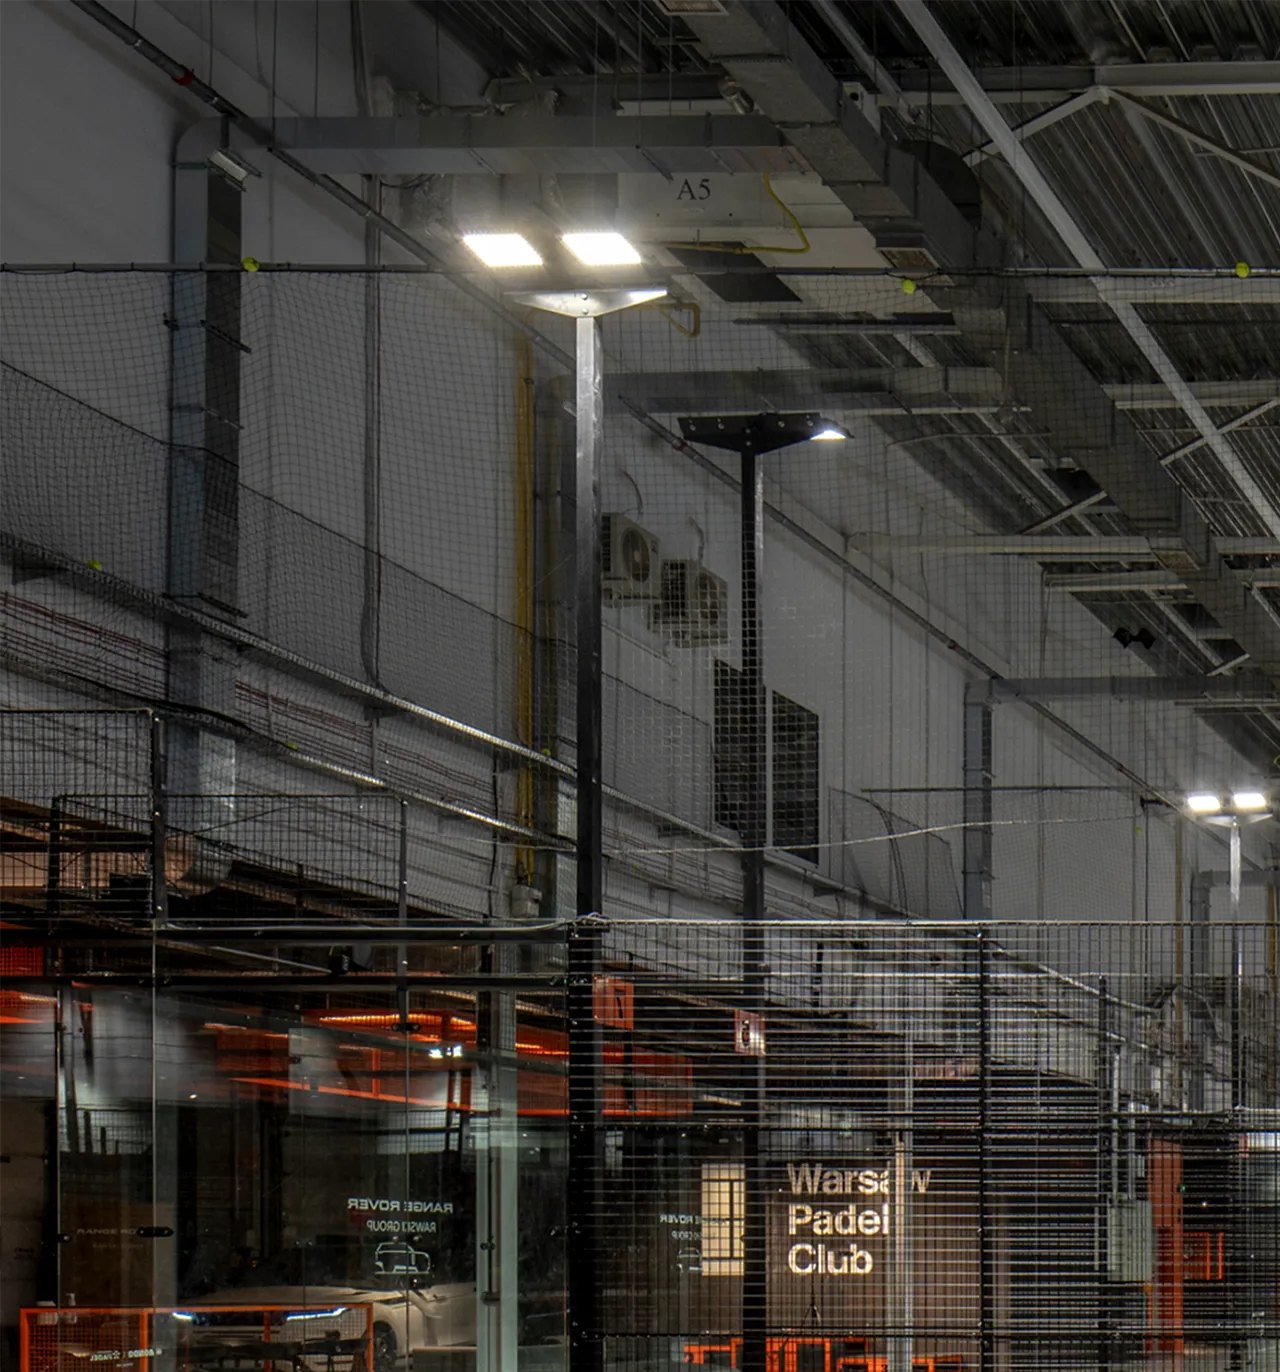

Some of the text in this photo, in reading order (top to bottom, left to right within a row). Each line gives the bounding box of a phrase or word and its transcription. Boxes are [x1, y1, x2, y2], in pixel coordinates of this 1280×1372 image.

[677, 178, 711, 201] A5
[788, 1204, 890, 1235] Padel
[788, 1243, 873, 1274] Club
